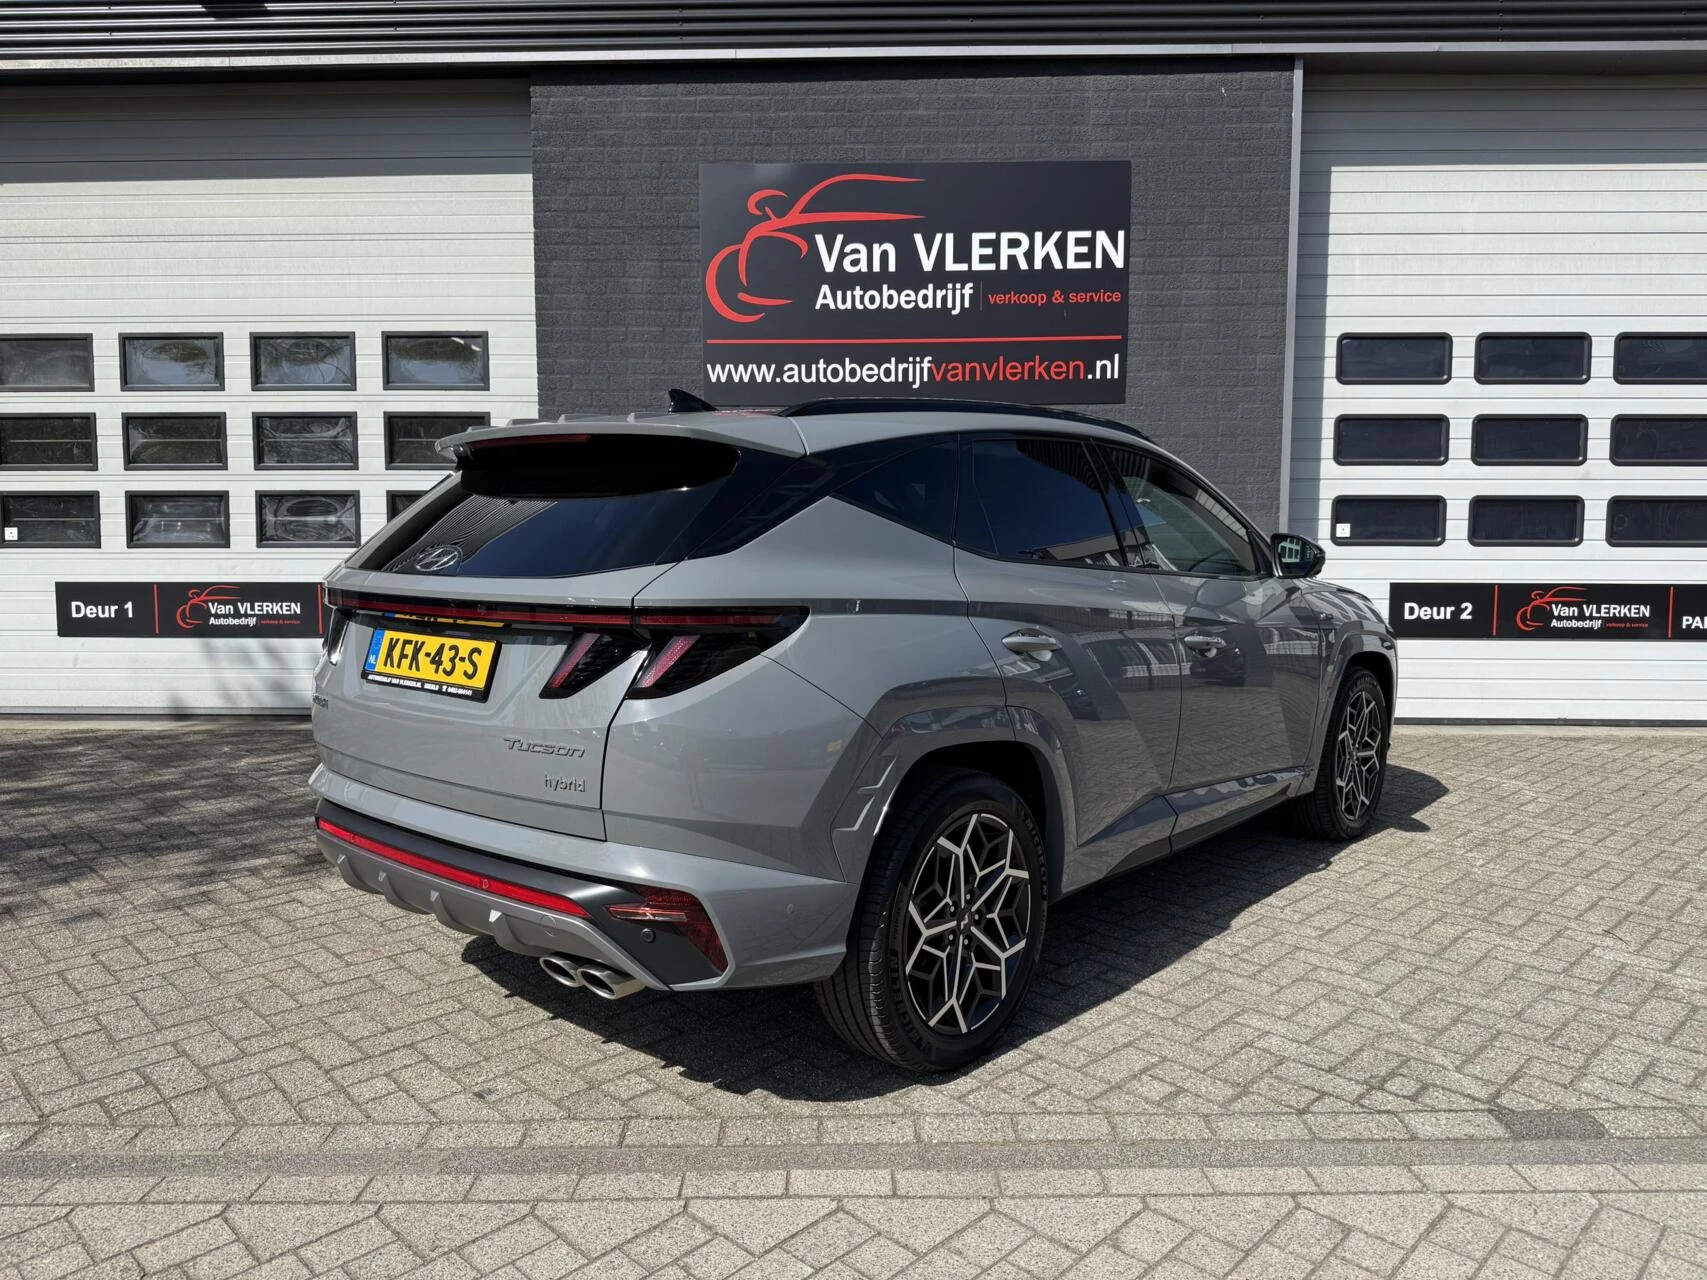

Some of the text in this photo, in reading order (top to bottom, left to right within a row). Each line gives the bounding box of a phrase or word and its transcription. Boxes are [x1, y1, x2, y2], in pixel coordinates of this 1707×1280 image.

[815, 230, 1125, 273] Van VLERKEN
[815, 282, 1121, 315] Autobedrijf verkoop & service
[706, 353, 1120, 389] www.autobedrijfvanvlerken.nl
[71, 601, 134, 618] Deur 1
[208, 602, 301, 615] Van VLERKEN
[1403, 602, 1473, 620] Deur 2
[1551, 603, 1650, 618] Van VLERKEN
[209, 616, 257, 627] Autobedrijf
[1550, 618, 1602, 630] Autobedrijf
[368, 654, 376, 665] NL
[383, 637, 482, 680] KFK-43-S
[544, 772, 586, 793] hybrid
